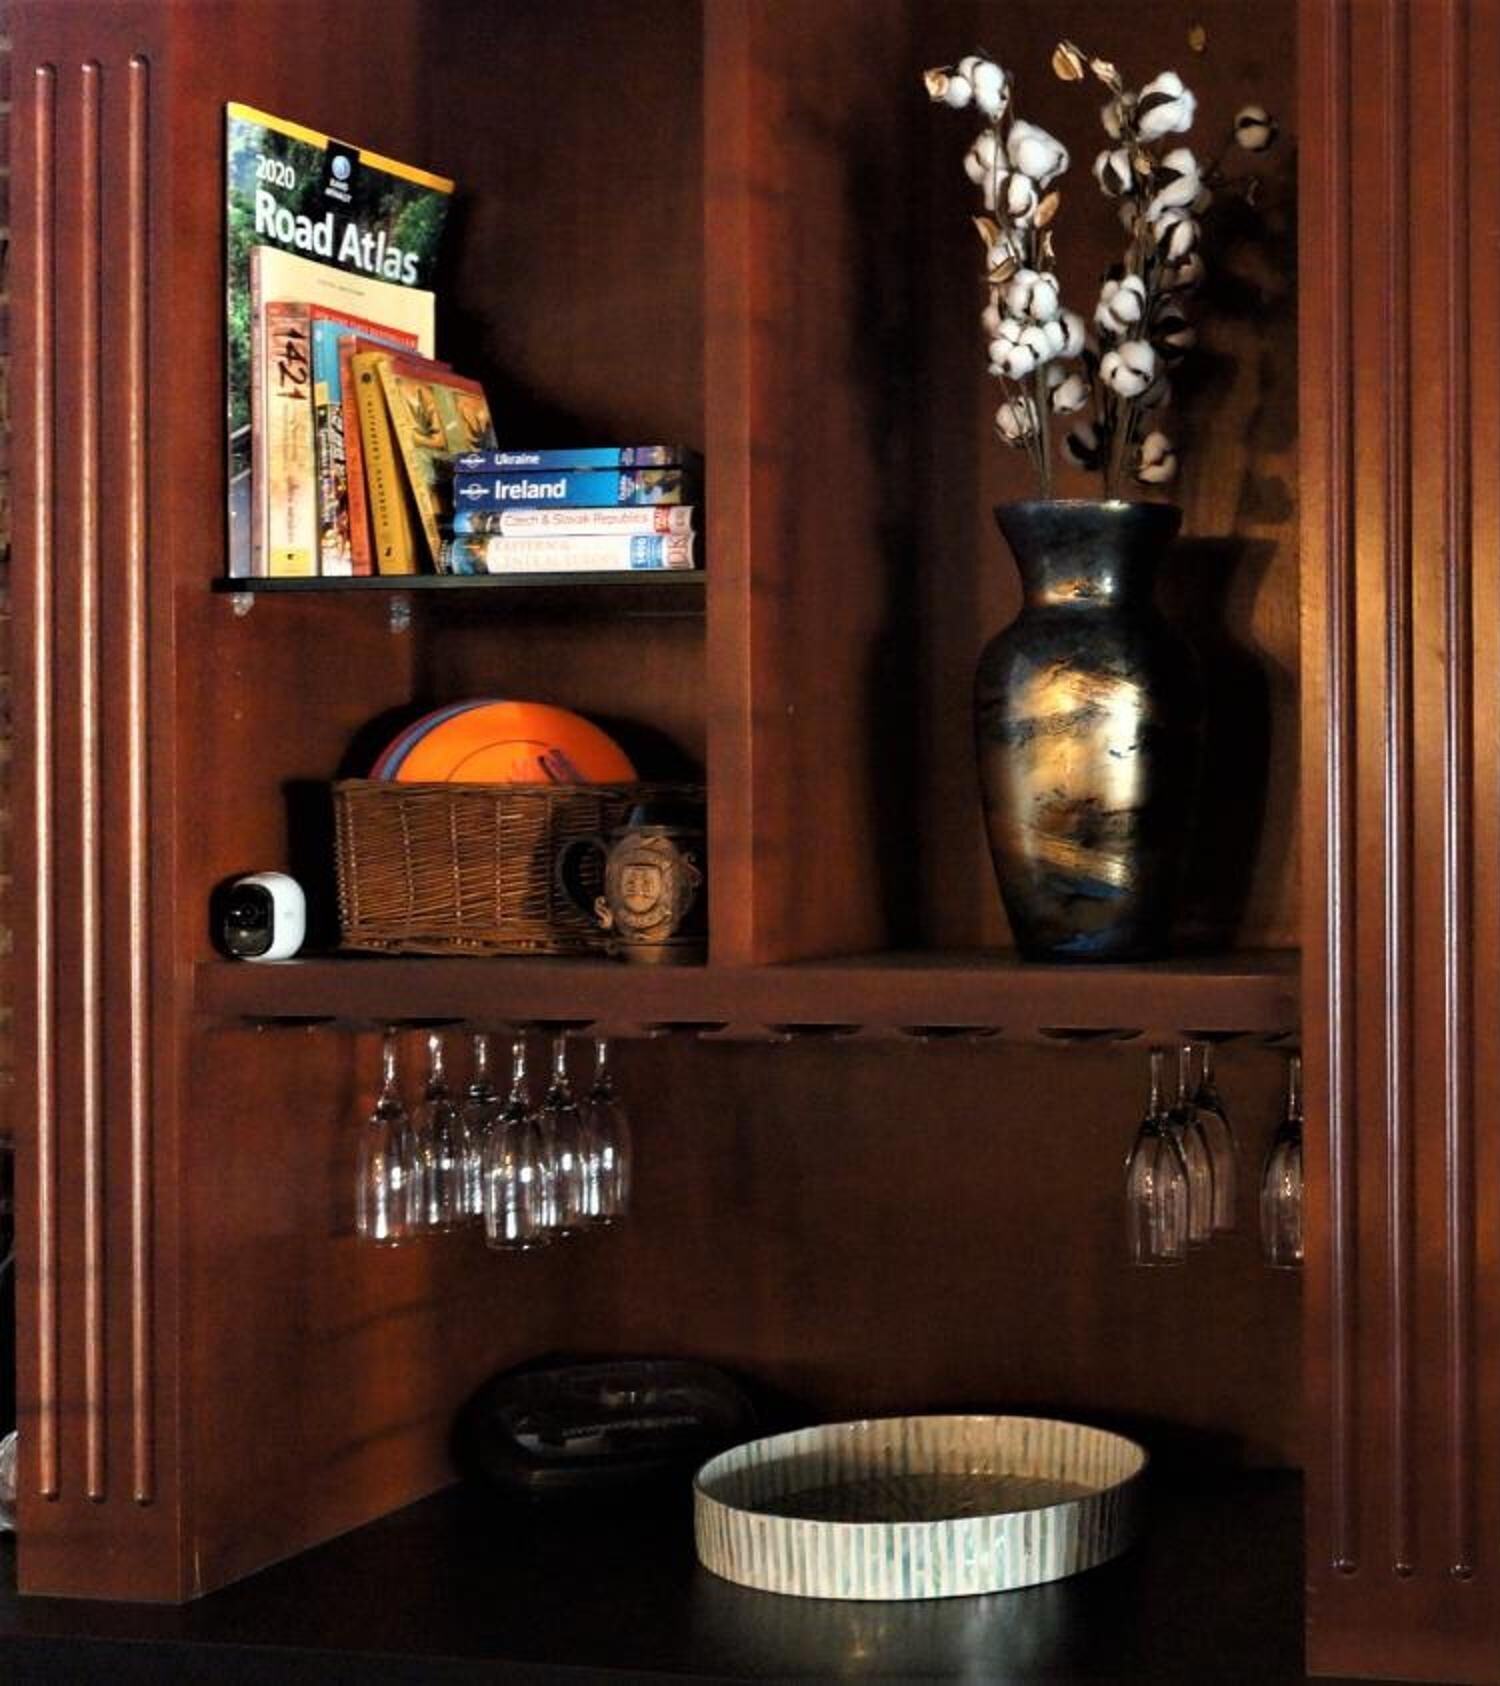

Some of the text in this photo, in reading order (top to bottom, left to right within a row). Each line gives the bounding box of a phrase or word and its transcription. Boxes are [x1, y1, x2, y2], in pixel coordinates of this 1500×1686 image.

[256, 154, 295, 190] 2020
[255, 188, 419, 285] Road Atlas
[276, 325, 308, 400] 1421
[494, 454, 540, 466] Ukraine
[494, 478, 567, 500] Ireland
[503, 513, 538, 526] Czech
[542, 513, 551, 526] &
[552, 512, 592, 526] Slovak
[593, 512, 649, 527] Republics
